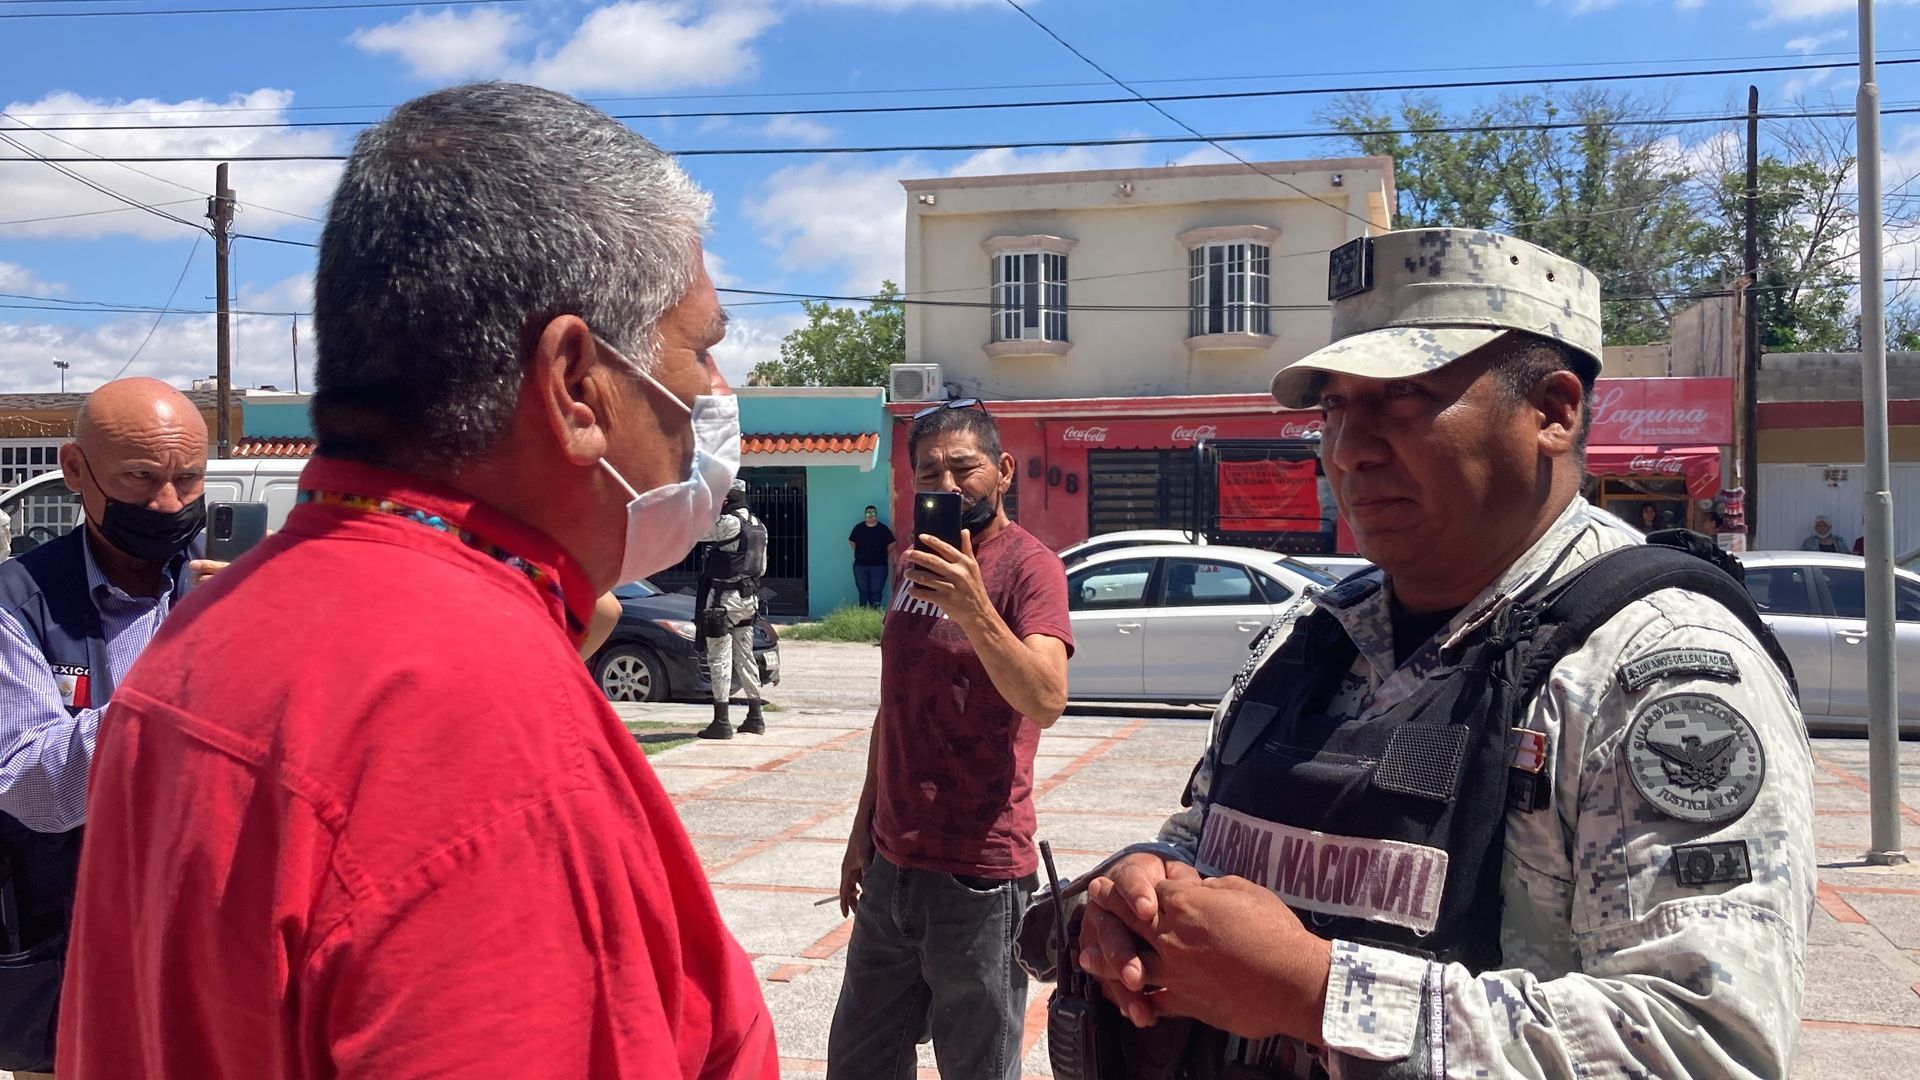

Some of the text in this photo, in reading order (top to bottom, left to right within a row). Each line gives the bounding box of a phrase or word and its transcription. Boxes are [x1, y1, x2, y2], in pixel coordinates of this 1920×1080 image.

[1592, 387, 1708, 440] Laguna
[53, 665, 89, 676] EXIC
[1651, 655, 1673, 669] AÑOS
[1634, 699, 1749, 751] GUARDIA NACIONAL
[1656, 787, 1716, 811] JUSTICIA
[1202, 812, 1434, 921] UARDIA NACIONAL
